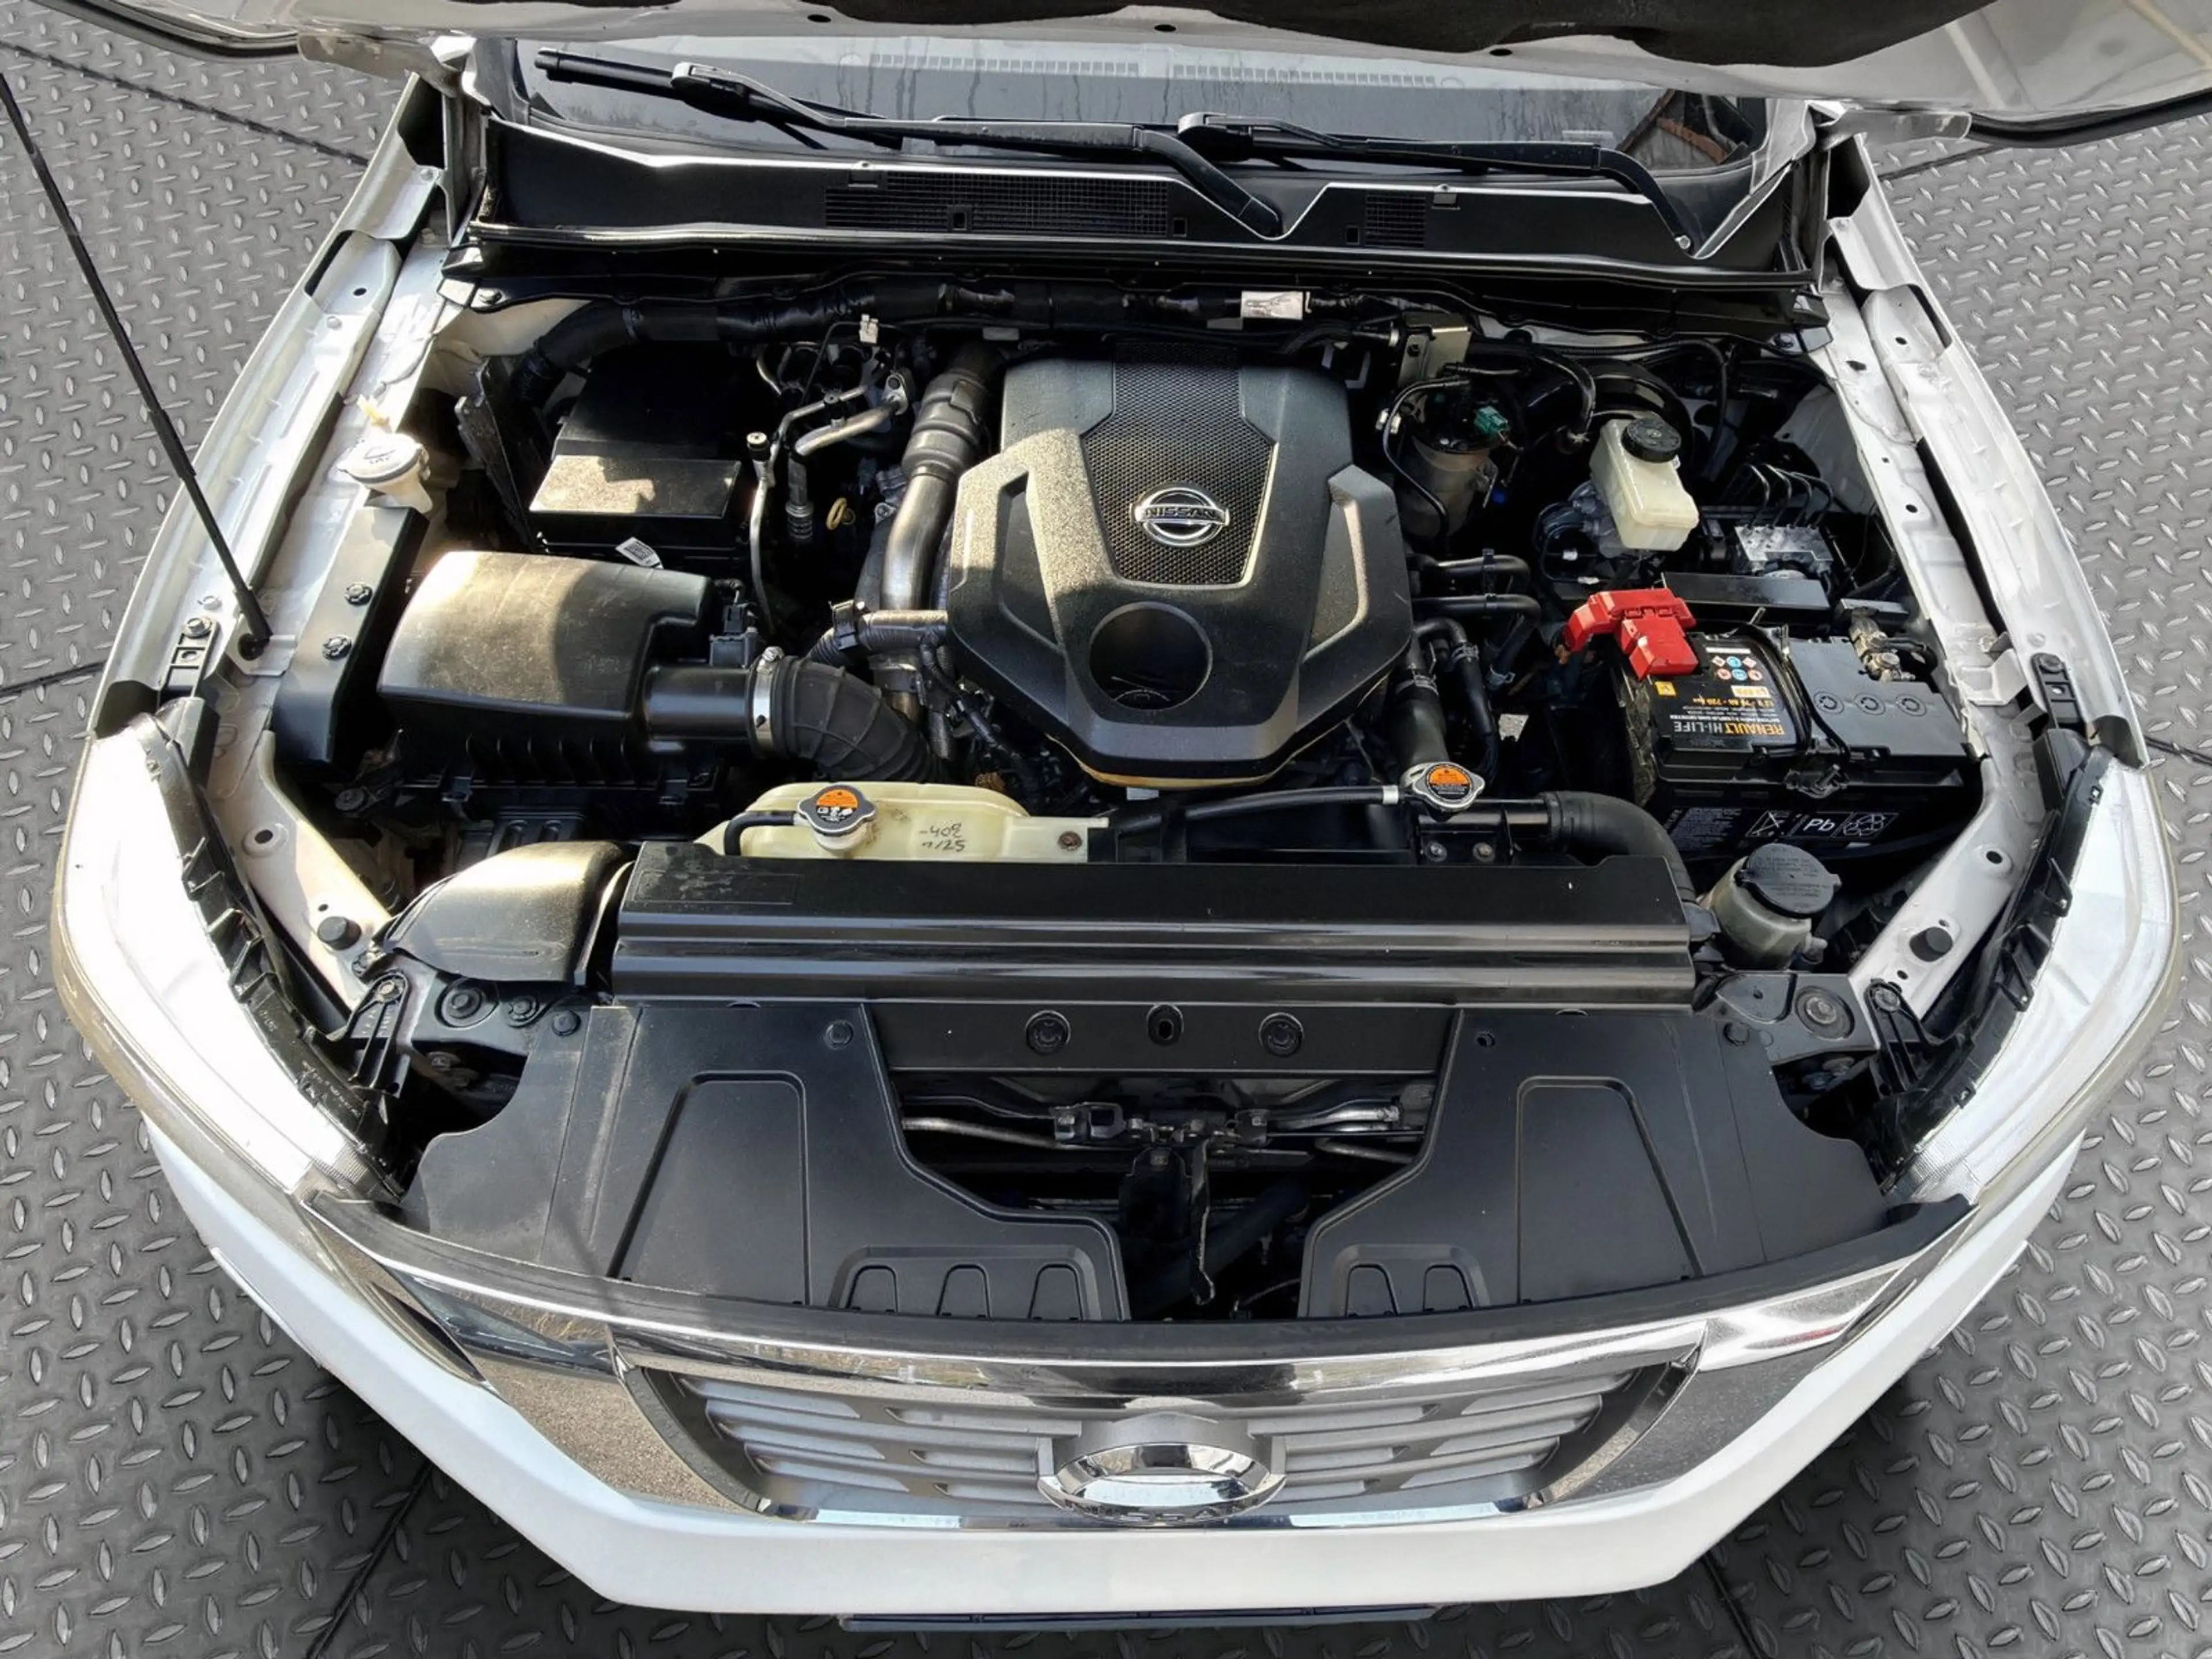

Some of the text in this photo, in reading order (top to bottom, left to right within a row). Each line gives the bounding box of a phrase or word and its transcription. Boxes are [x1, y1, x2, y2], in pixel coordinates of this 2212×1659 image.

[1144, 506, 1218, 520] NISSAN
[1725, 721, 1785, 736] RENAULT
[1802, 819, 1836, 832] Pb
